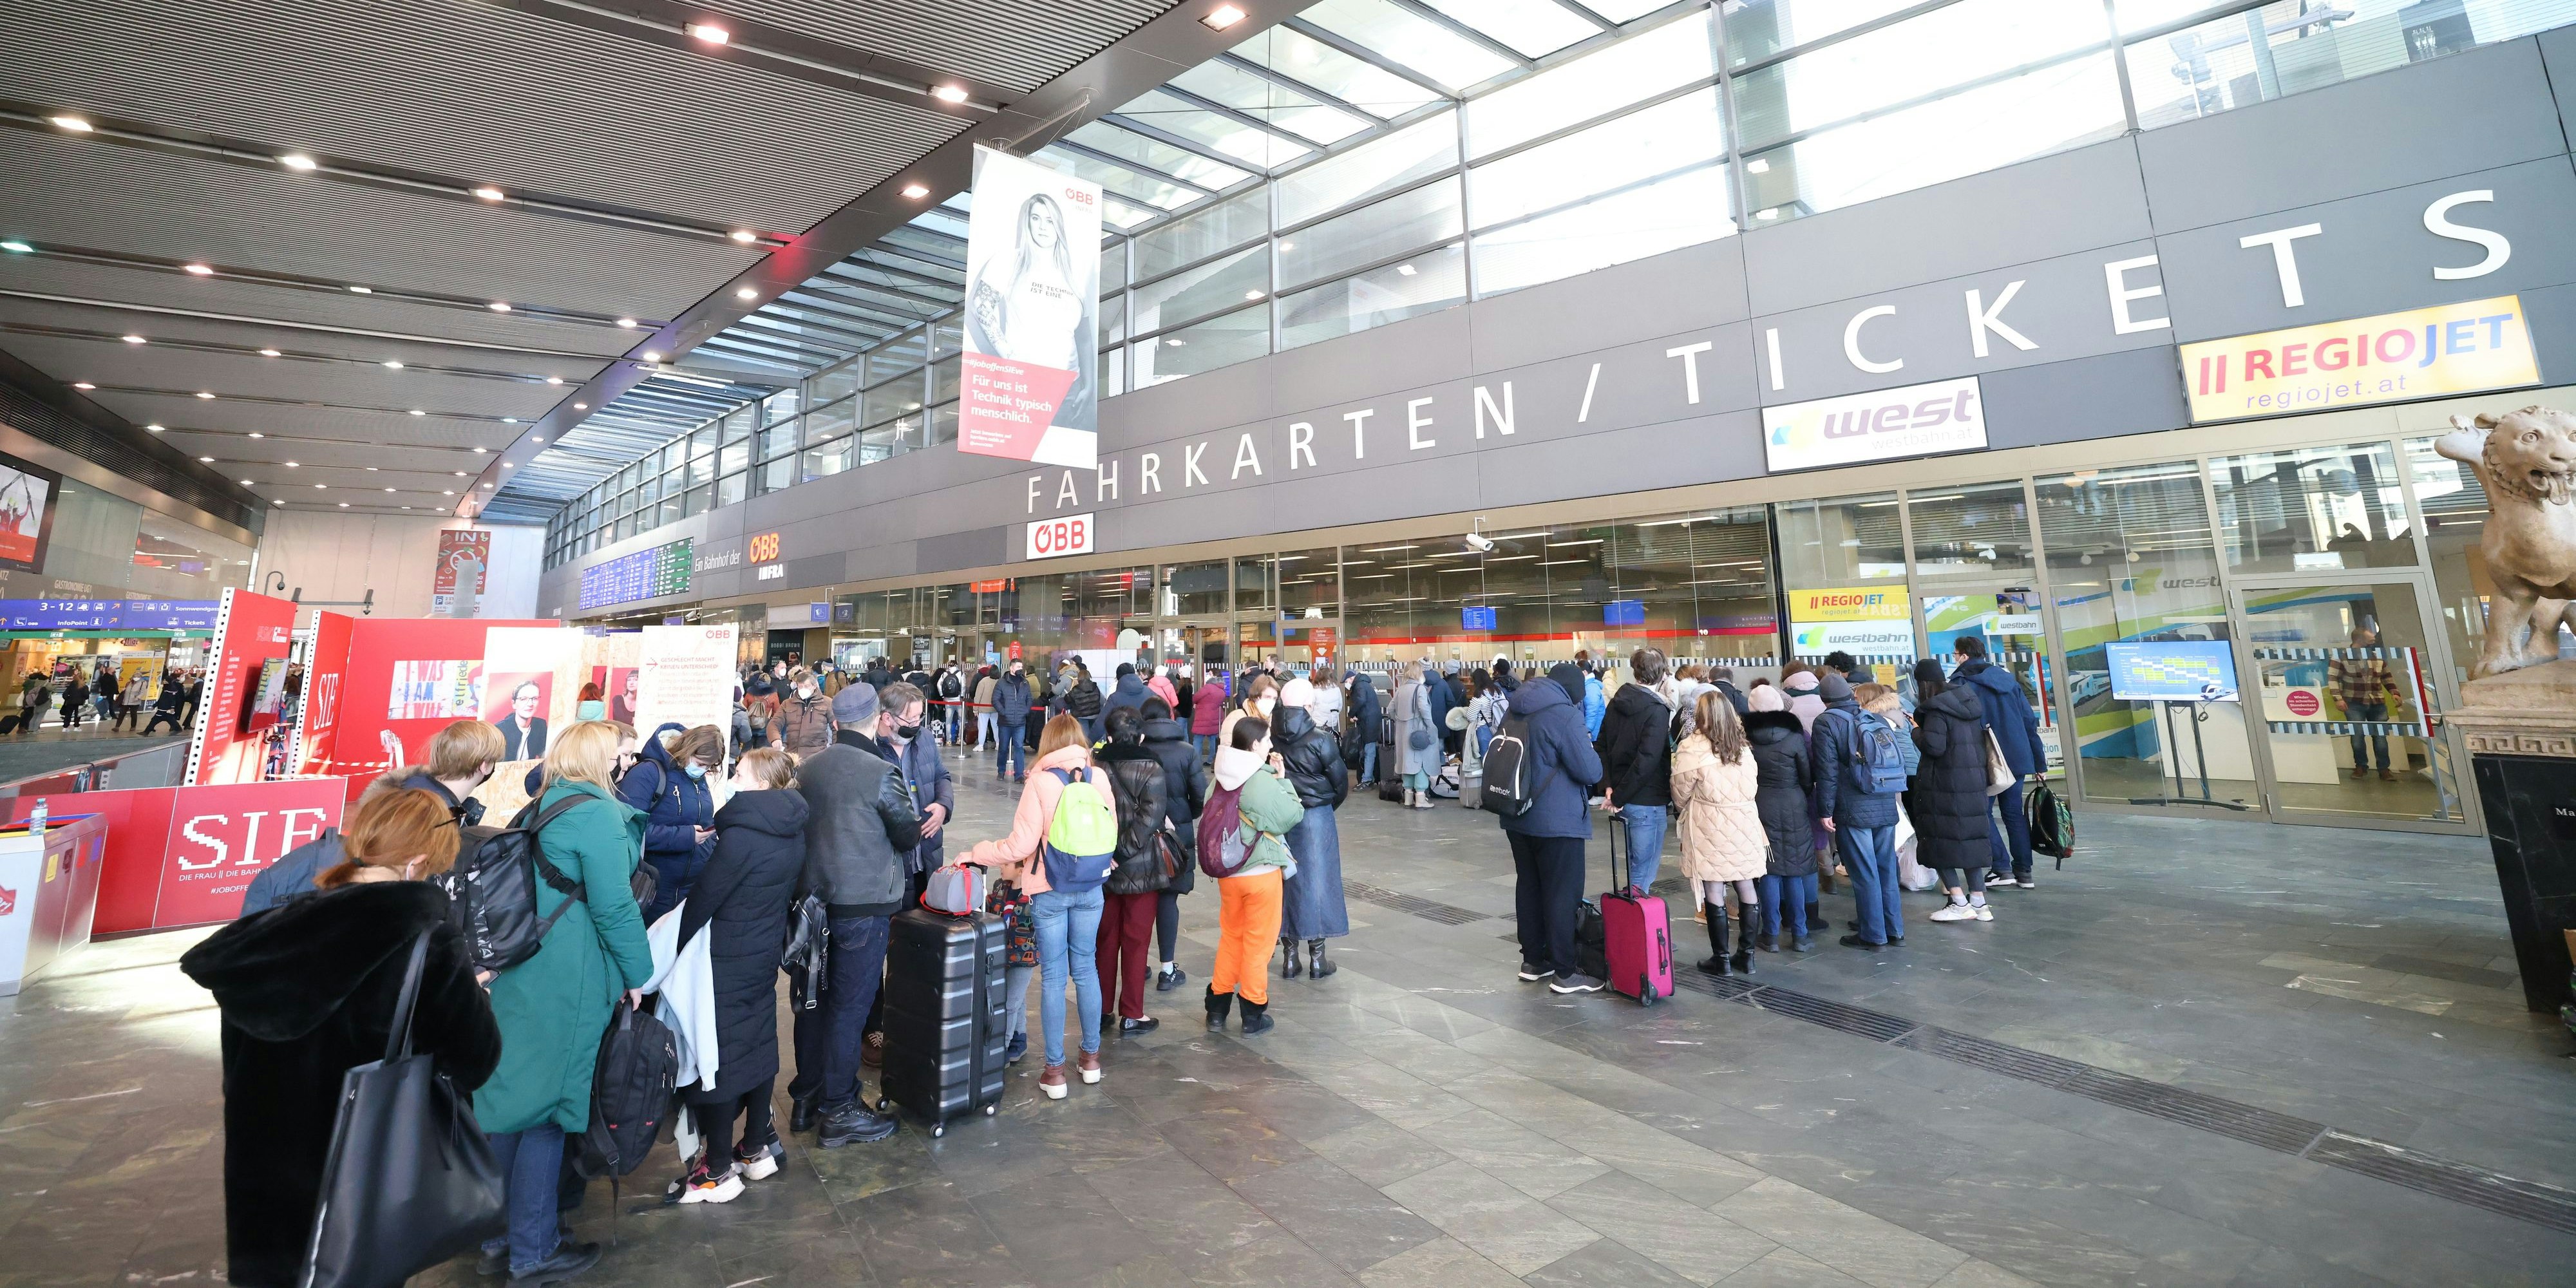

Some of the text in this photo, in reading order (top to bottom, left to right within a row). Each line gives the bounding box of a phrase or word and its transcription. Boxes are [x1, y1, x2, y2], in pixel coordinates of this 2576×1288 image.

[1066, 187, 1094, 205] ÖBB
[1045, 290, 1062, 299] EINE
[1028, 189, 2511, 514] FAHRKARTEN / TICKETS
[2244, 313, 2513, 382] REGIOJET
[972, 374, 1028, 393] Für uns ist
[2247, 374, 2407, 409] regiojet.at
[971, 389, 1052, 412] Technik typisch
[971, 406, 1033, 424] menschlich.
[1824, 390, 1975, 439] west
[1871, 426, 1973, 450] westbahn.at
[1034, 520, 1085, 554] ÖBB
[750, 533, 779, 564] ÖBB
[694, 549, 741, 573] Ein Bahnhof der
[759, 564, 784, 581] INFRA
[40, 603, 48, 611] 3
[59, 603, 73, 611] 12
[1822, 594, 1884, 607] REGIOJET
[706, 630, 730, 639] ÖBB
[1829, 633, 1908, 644] westbahn
[417, 660, 445, 682] WAS
[413, 681, 434, 701] AM
[314, 673, 339, 730] SIE
[2043, 744, 2060, 753] tion
[1490, 784, 1510, 796] Reebok
[194, 872, 216, 880] FRAU
[211, 884, 249, 894] #JOBOFFE
